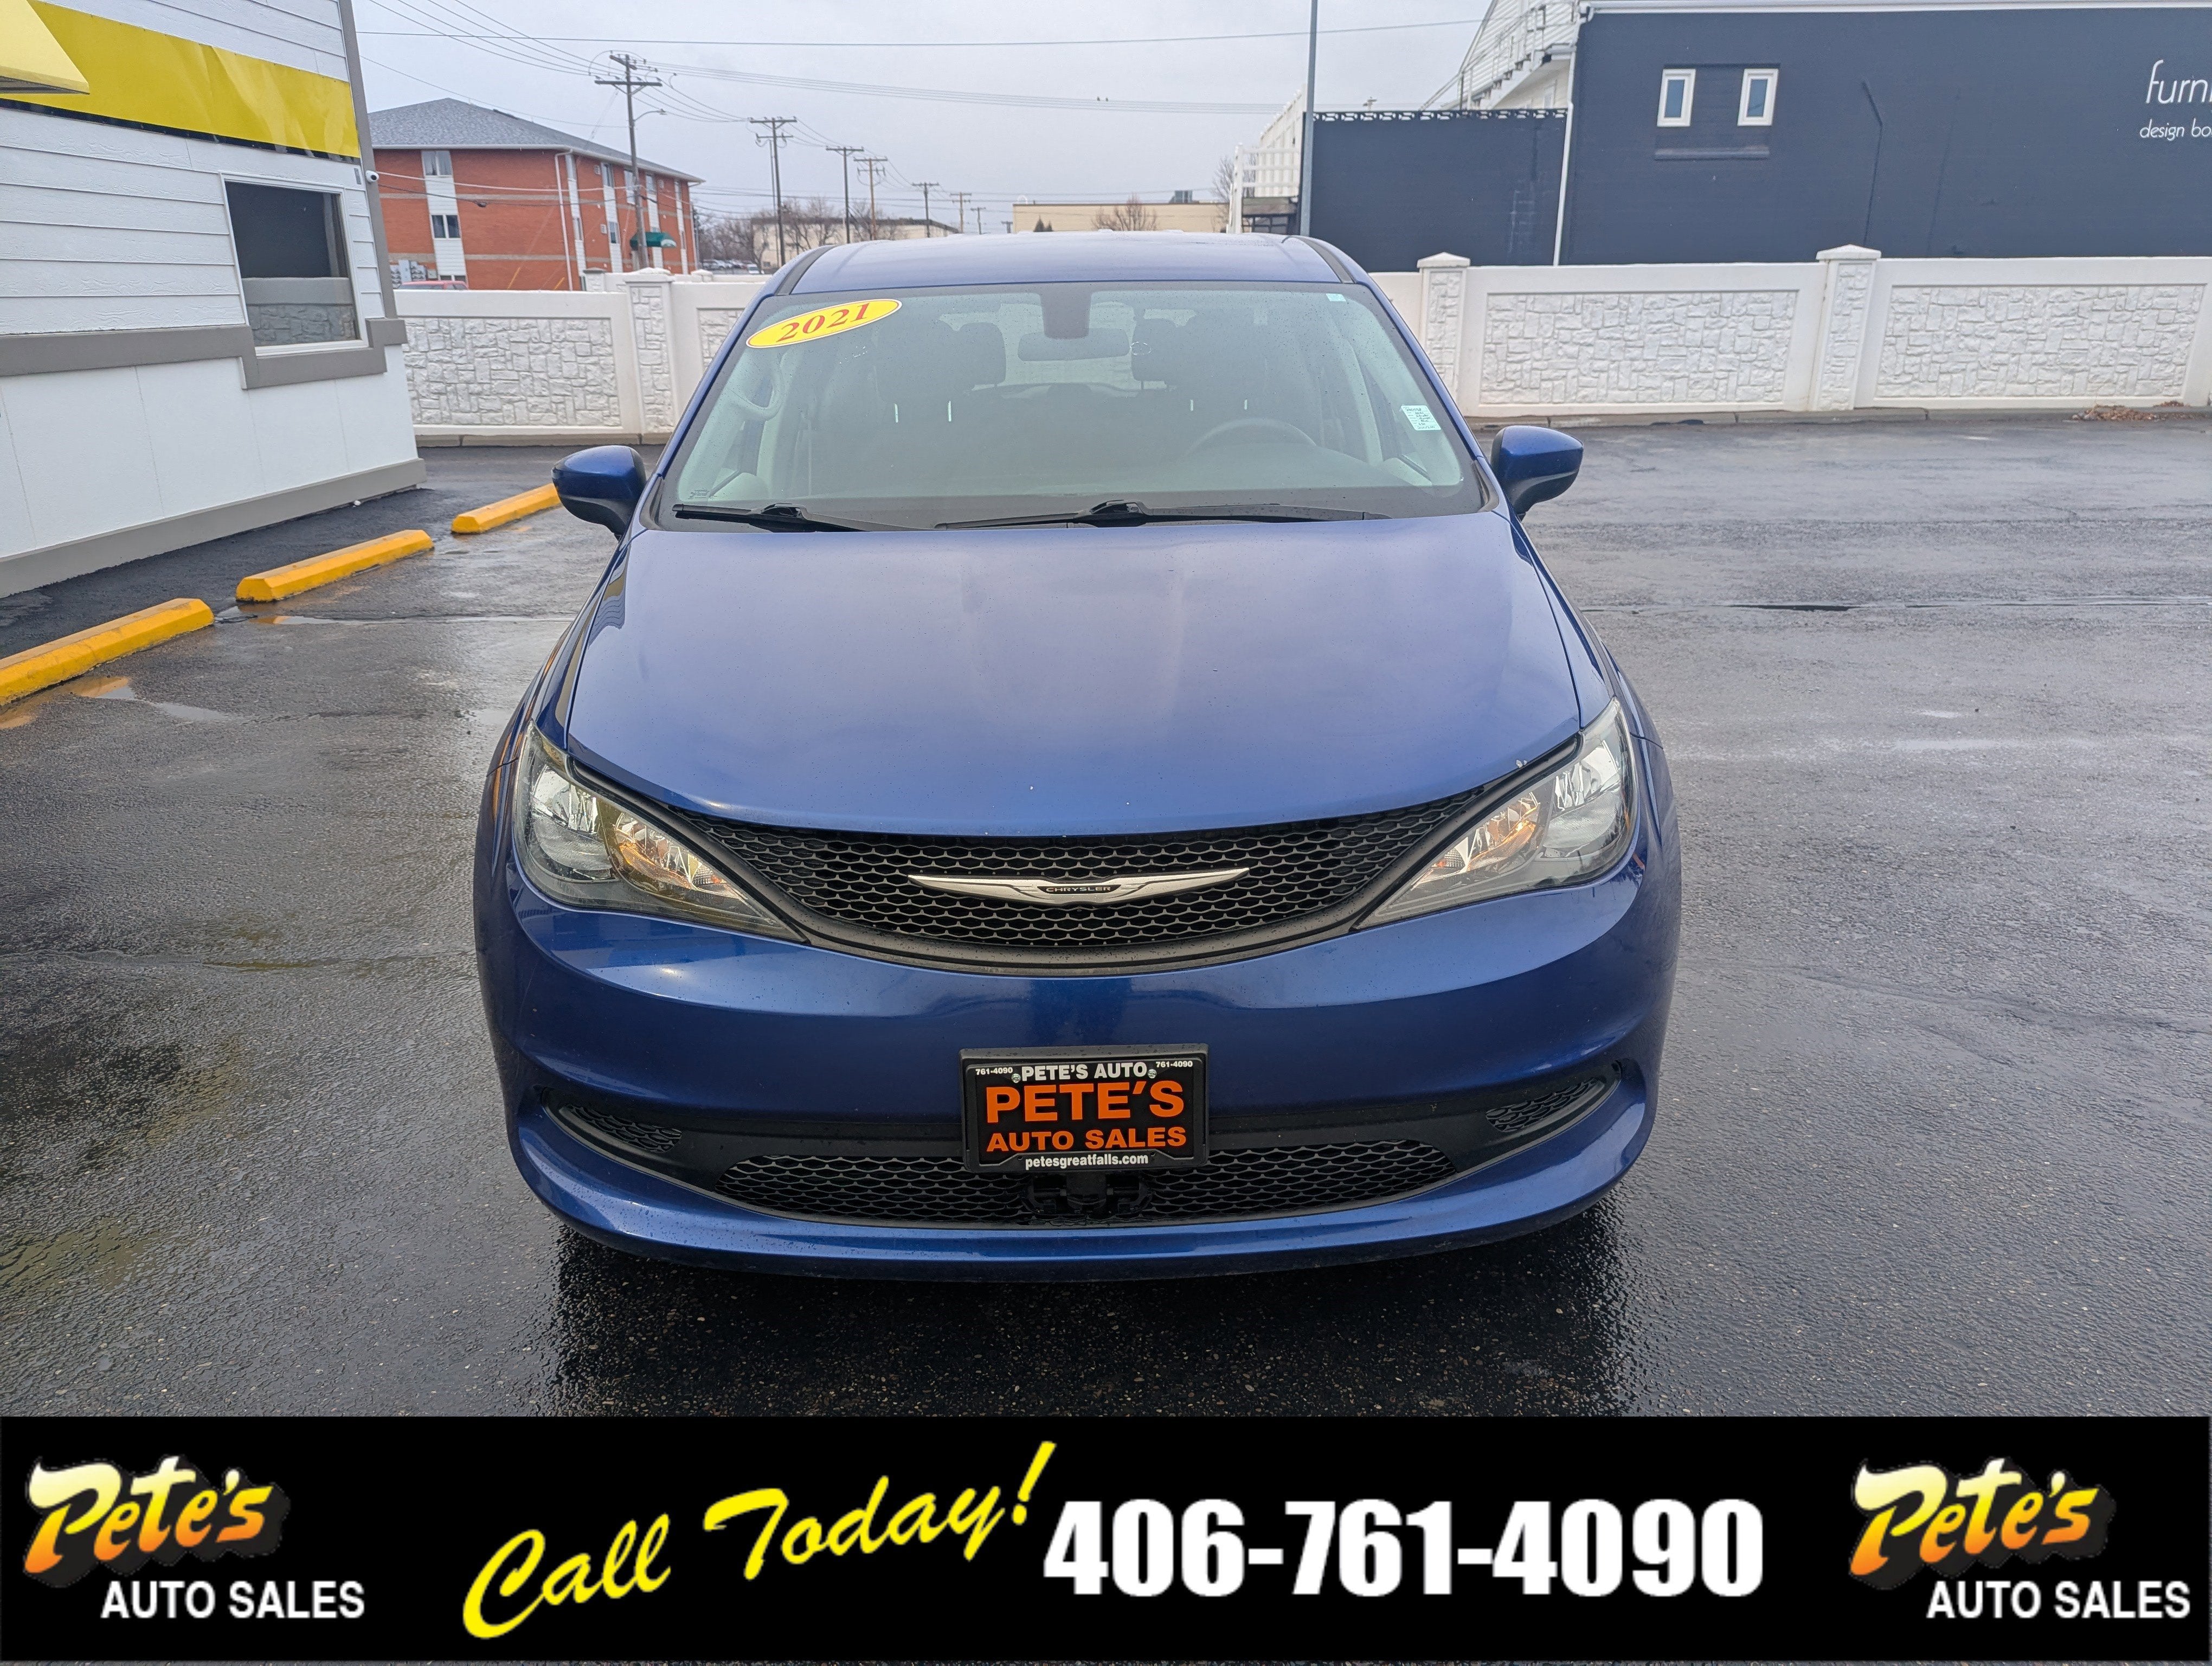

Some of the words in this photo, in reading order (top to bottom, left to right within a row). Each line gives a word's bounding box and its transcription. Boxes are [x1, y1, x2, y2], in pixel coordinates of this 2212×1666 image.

[2140, 119, 2184, 140] design
[2191, 118, 2212, 137] bo
[776, 303, 870, 343] 2021
[975, 1067, 1013, 1075] 761-4090
[1022, 1065, 1088, 1081] PETE'S
[1094, 1062, 1147, 1078] AUTO
[987, 1081, 1184, 1123] PETE'S
[987, 1131, 1073, 1151] AUTO
[1085, 1127, 1186, 1149] SALES
[1026, 1154, 1148, 1170] petesgreatfalls.com
